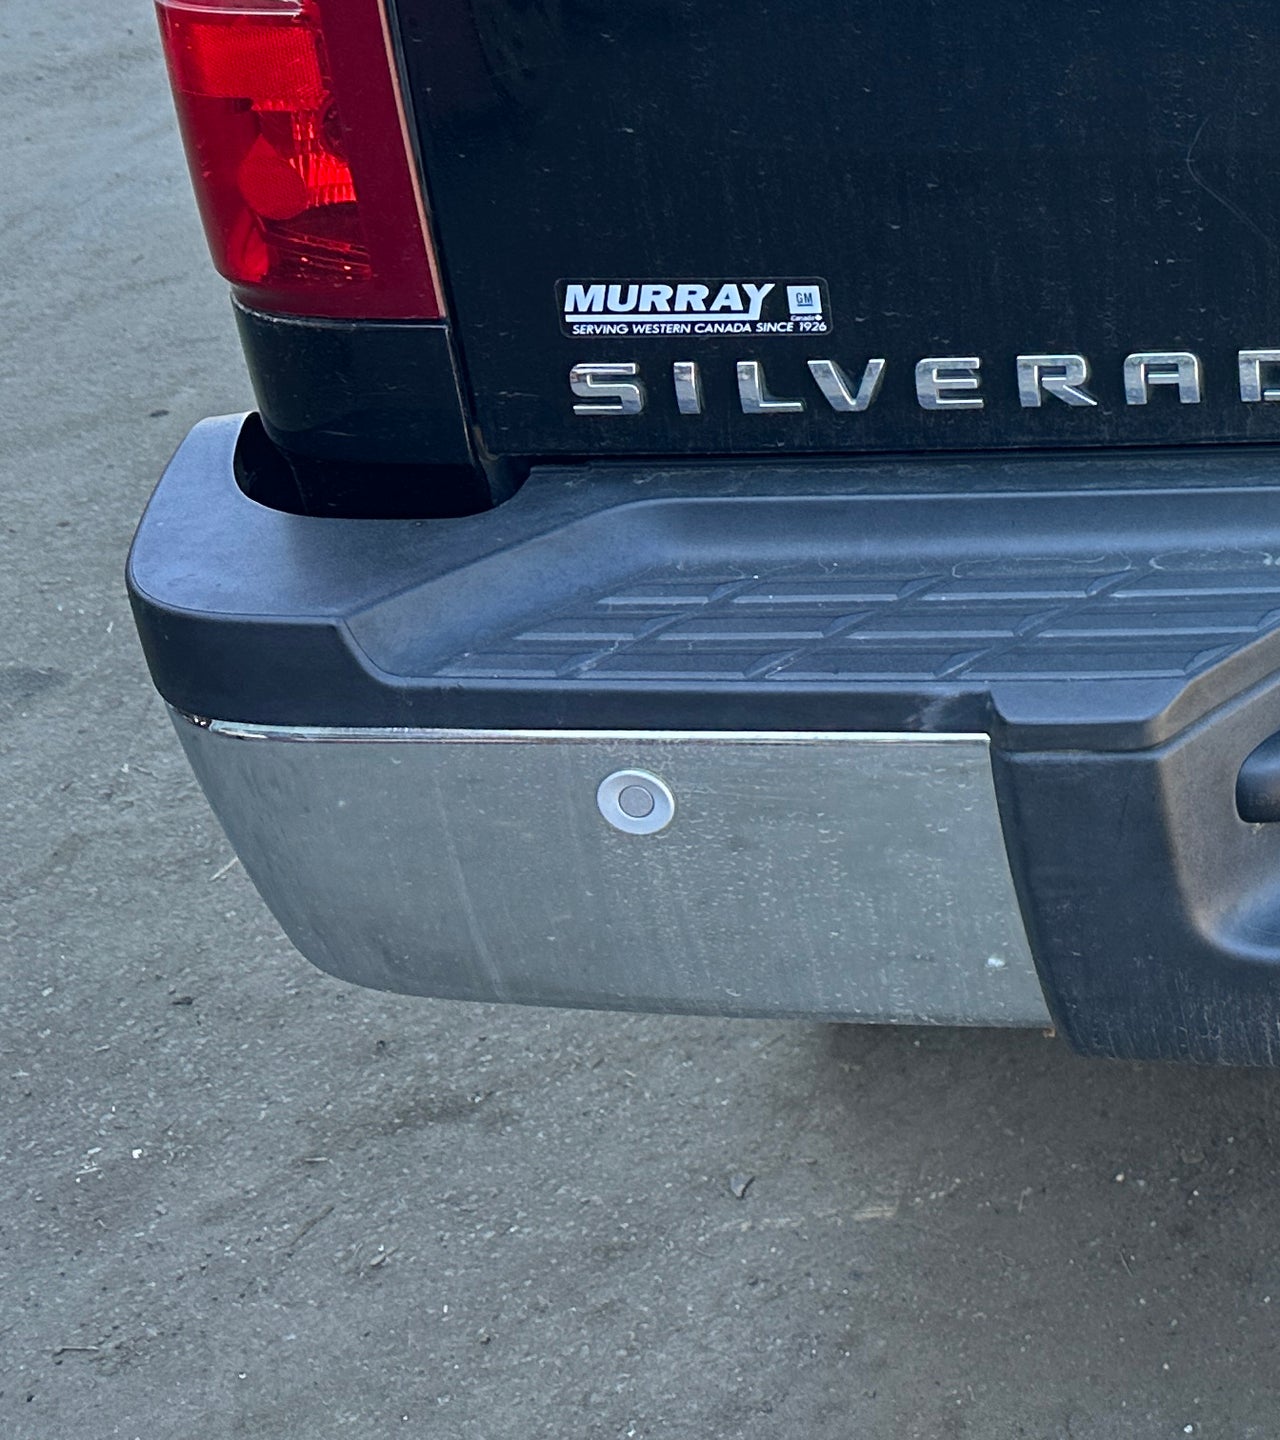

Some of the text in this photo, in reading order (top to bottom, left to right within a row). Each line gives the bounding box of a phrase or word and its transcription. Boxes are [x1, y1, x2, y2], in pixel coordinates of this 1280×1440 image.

[564, 284, 775, 321] MURRAY
[796, 292, 813, 307] GM
[572, 321, 827, 335] SERVING WESTERN CANADA SINCE 1926
